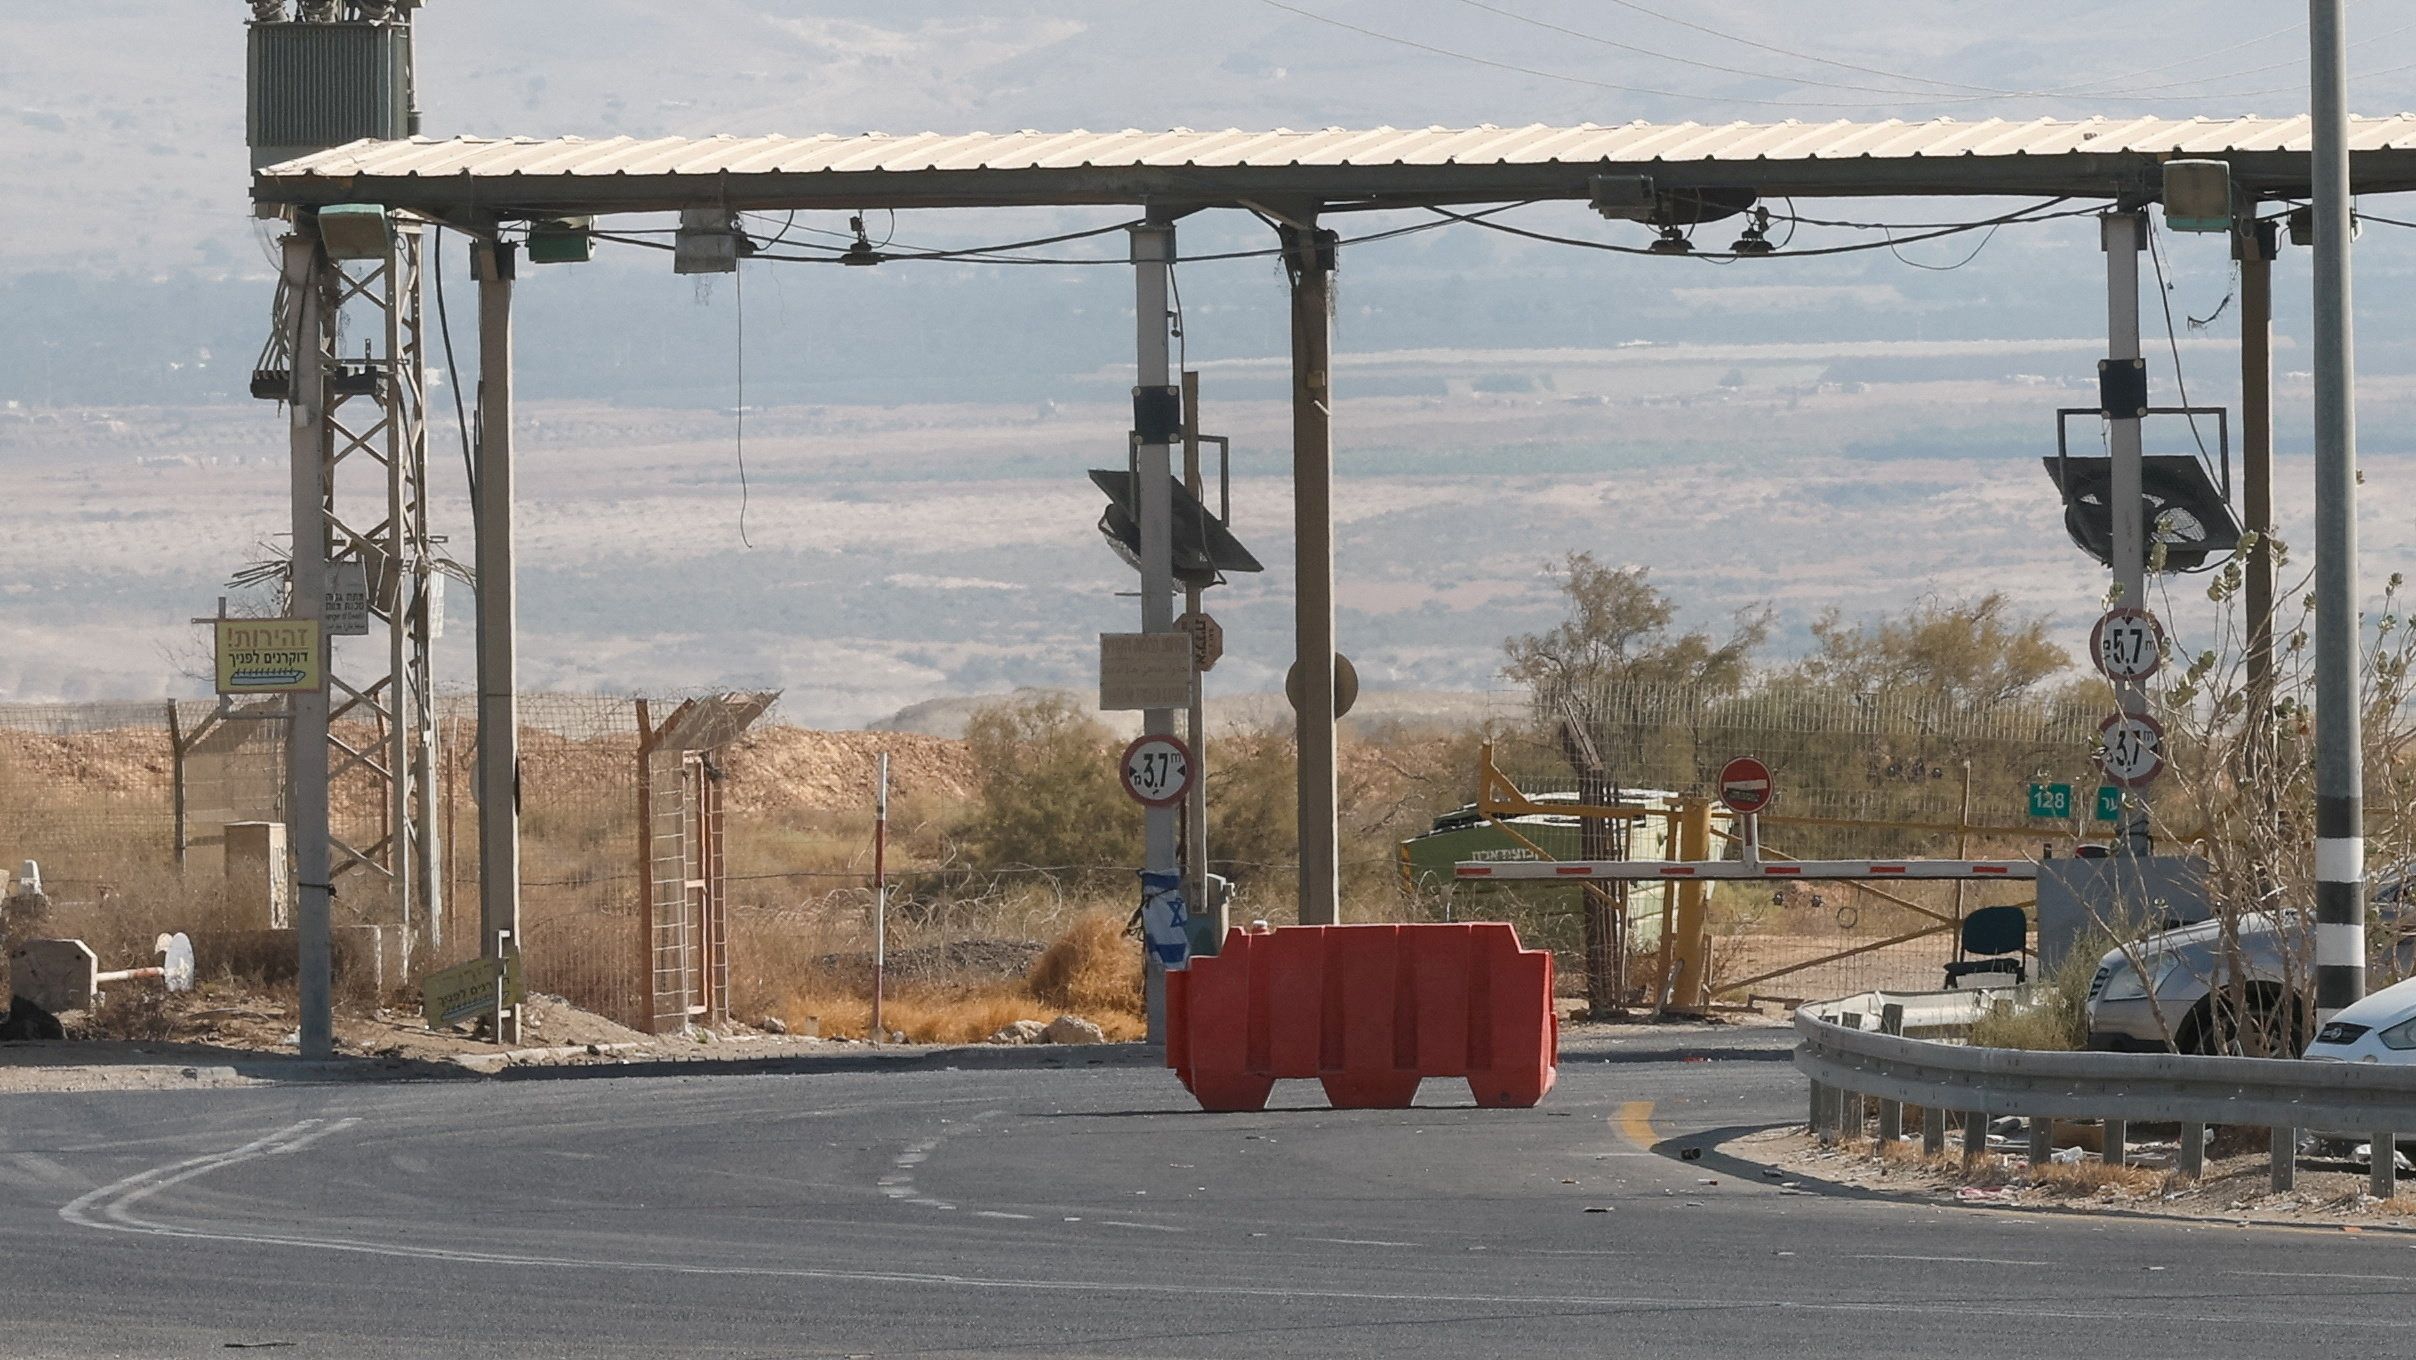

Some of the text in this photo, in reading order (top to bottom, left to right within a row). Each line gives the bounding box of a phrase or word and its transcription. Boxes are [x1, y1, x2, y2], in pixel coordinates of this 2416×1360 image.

[228, 628, 308, 648] זהירות!
[2113, 628, 2142, 664] 5.7
[228, 649, 308, 667] דוקרנים לפניך
[1143, 753, 1168, 788] 3.7
[1170, 752, 1182, 763] m
[2033, 791, 2065, 809] 128
[2101, 797, 2118, 812] ער
